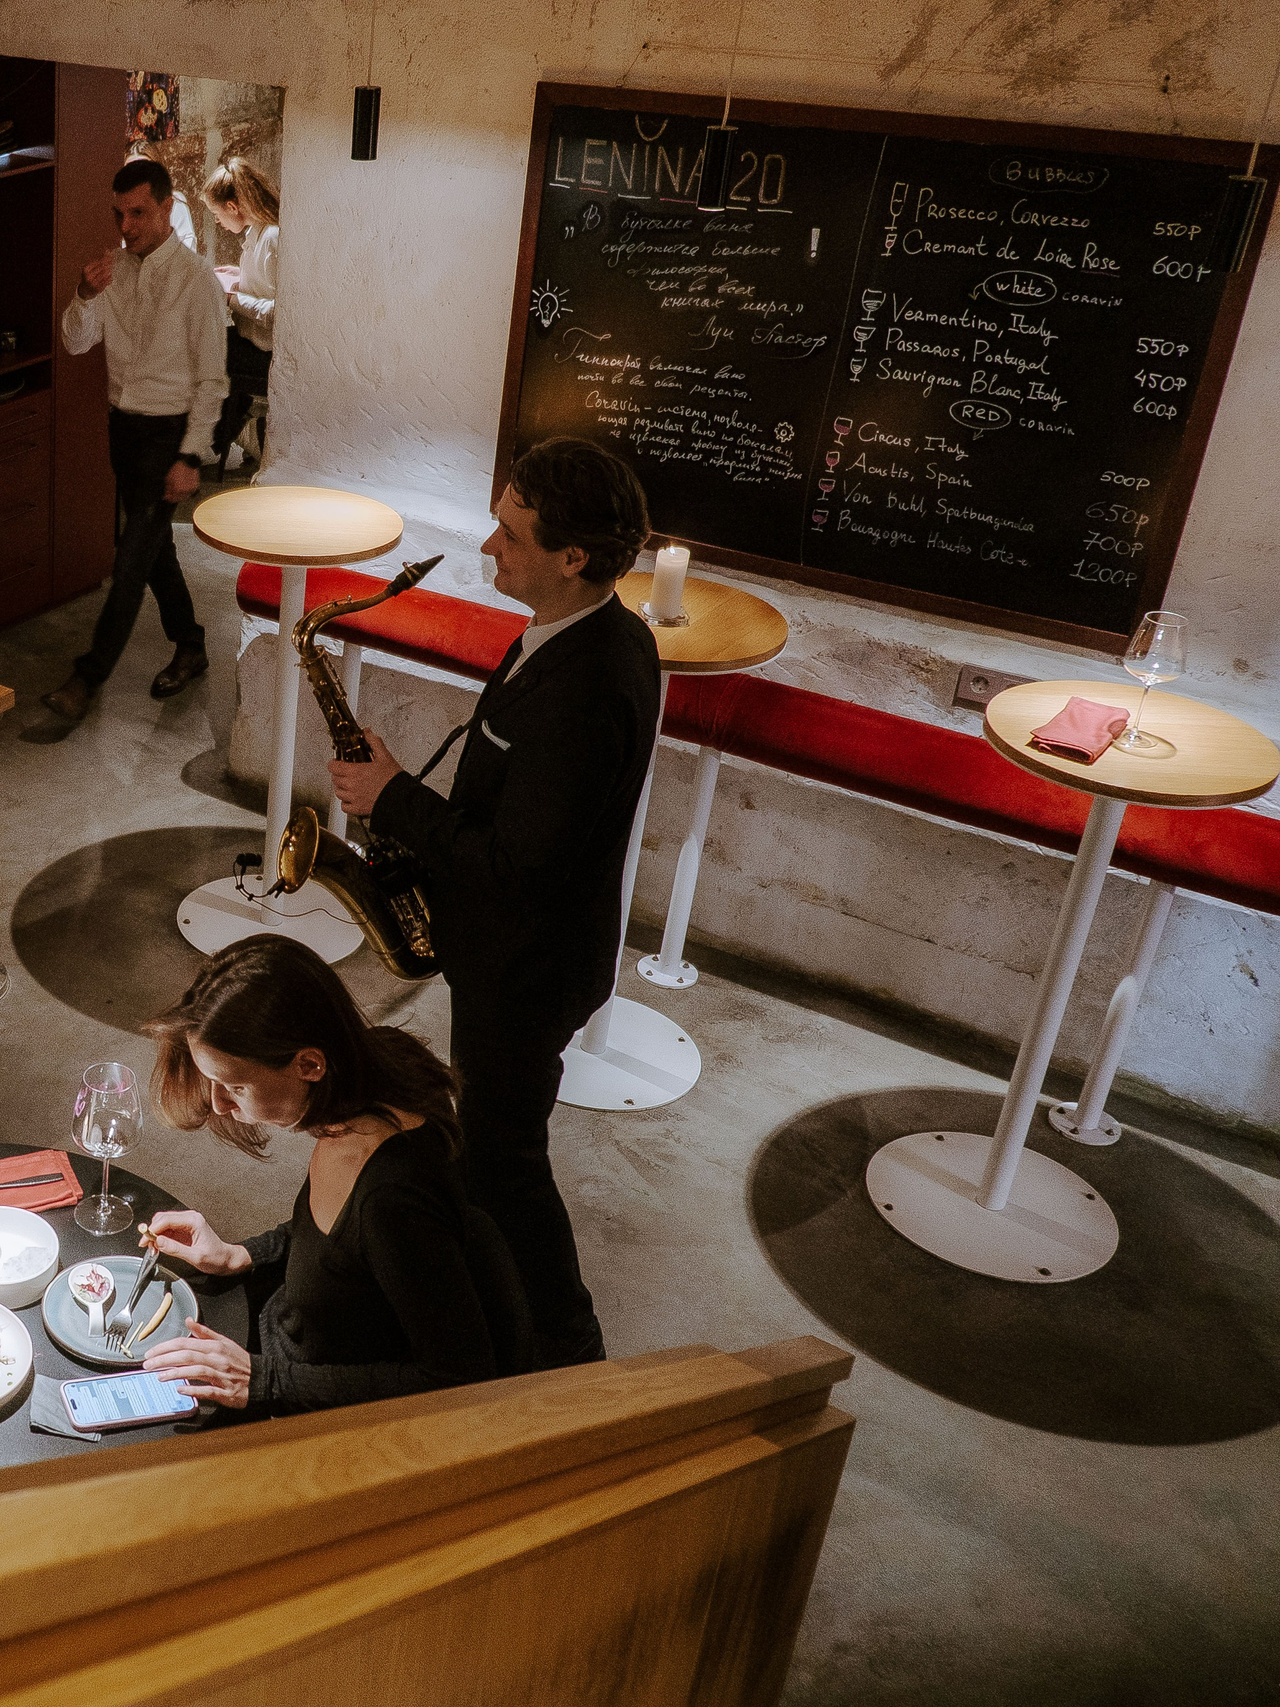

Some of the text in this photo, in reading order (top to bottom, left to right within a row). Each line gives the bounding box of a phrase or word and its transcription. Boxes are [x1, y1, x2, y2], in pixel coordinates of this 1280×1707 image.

[728, 150, 787, 205] 20
[702, 215, 754, 234] вина
[711, 239, 781, 257] больше
[902, 229, 989, 256] Cremant
[996, 236, 1020, 260] de
[1033, 238, 1076, 269] Loire
[1081, 241, 1121, 271] Rose
[995, 273, 1047, 298] white
[660, 296, 725, 309] книгах
[1008, 312, 1059, 346] Italy
[972, 339, 1050, 376] Portugal
[713, 364, 746, 381] вино
[875, 357, 962, 398] Sauvignon
[1026, 381, 1068, 411] Italy
[585, 389, 641, 414] Coravin
[923, 435, 969, 462] Italy
[924, 462, 972, 489] Spain
[842, 479, 873, 505] Von
